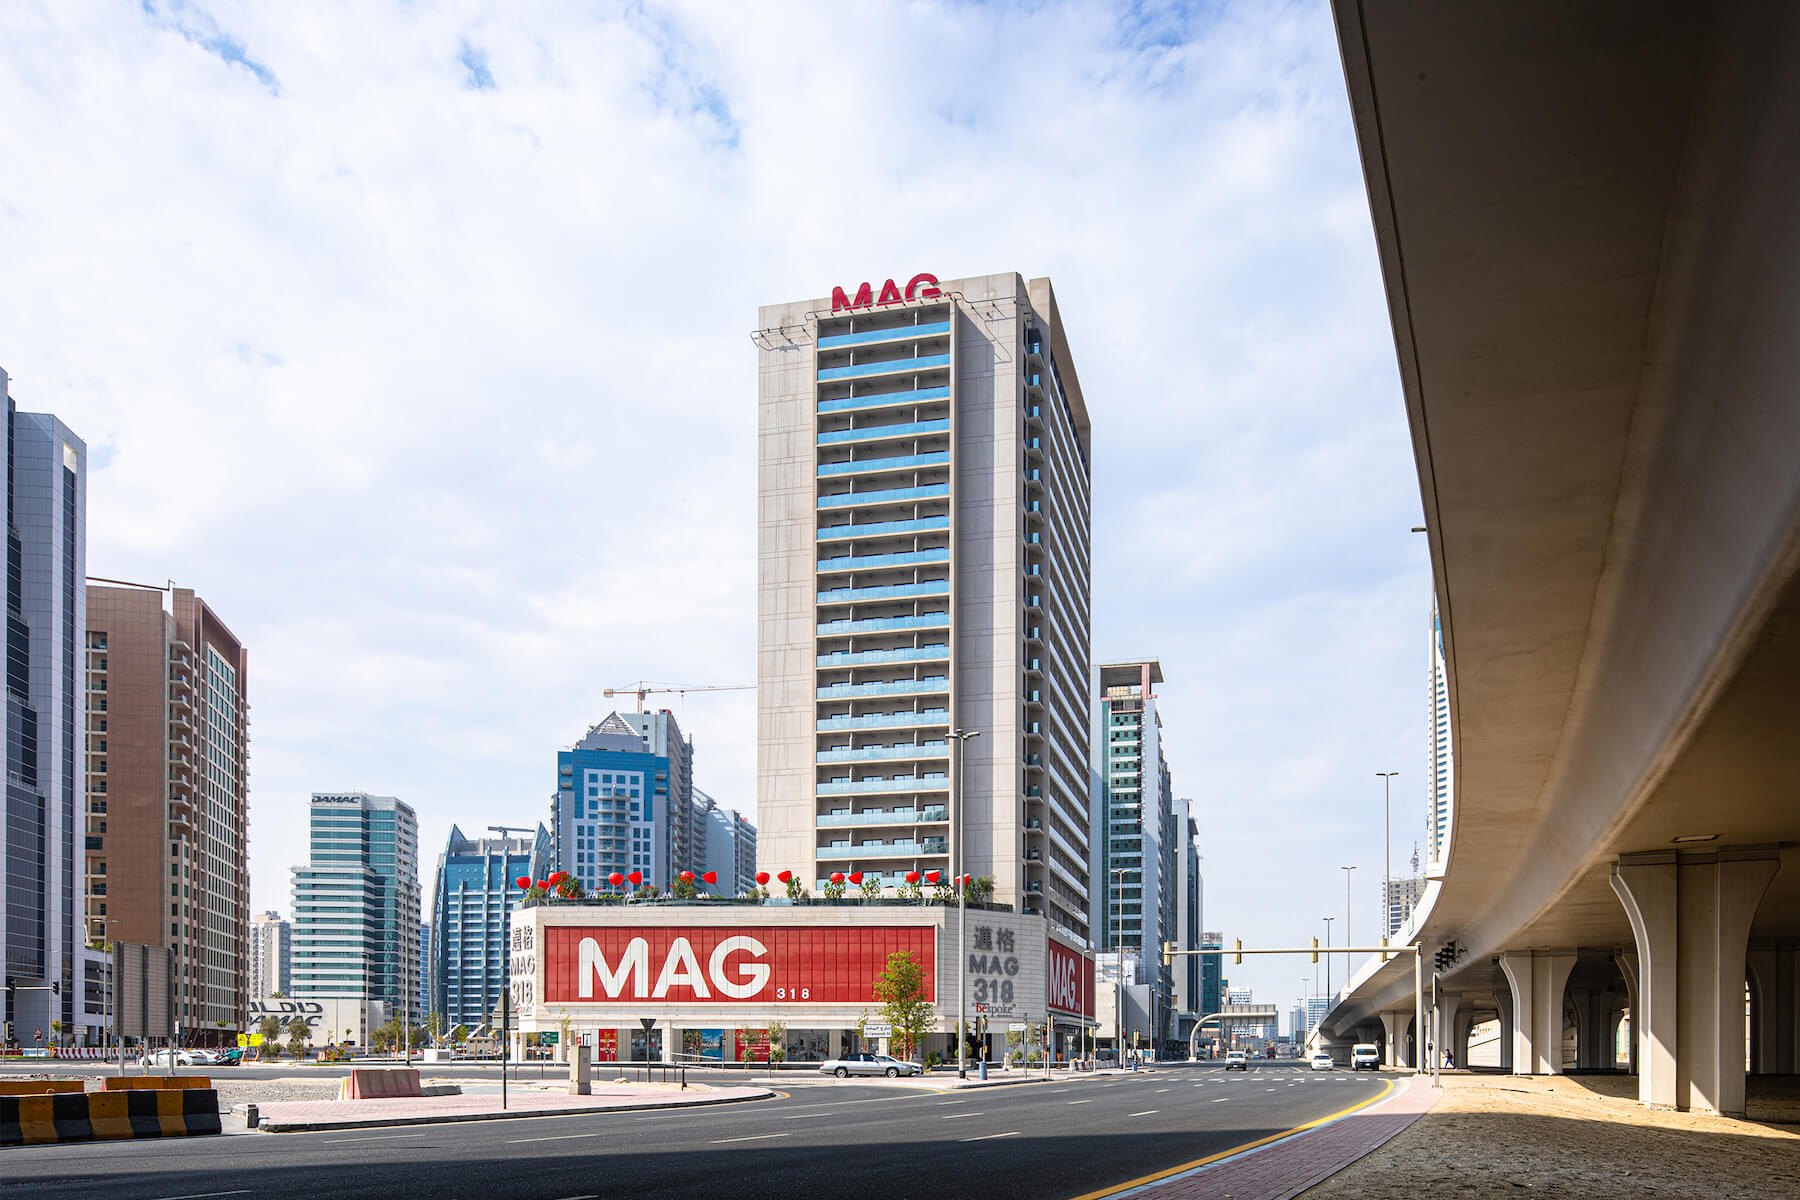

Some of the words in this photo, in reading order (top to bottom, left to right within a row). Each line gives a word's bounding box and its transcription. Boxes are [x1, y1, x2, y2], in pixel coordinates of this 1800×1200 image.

[832, 273, 941, 312] MAG
[510, 955, 536, 976] MAG
[579, 936, 770, 998] MAG
[776, 988, 810, 999] 318
[968, 954, 1019, 976] MAG
[1048, 949, 1076, 1009] MAG
[973, 978, 1014, 1003] 318
